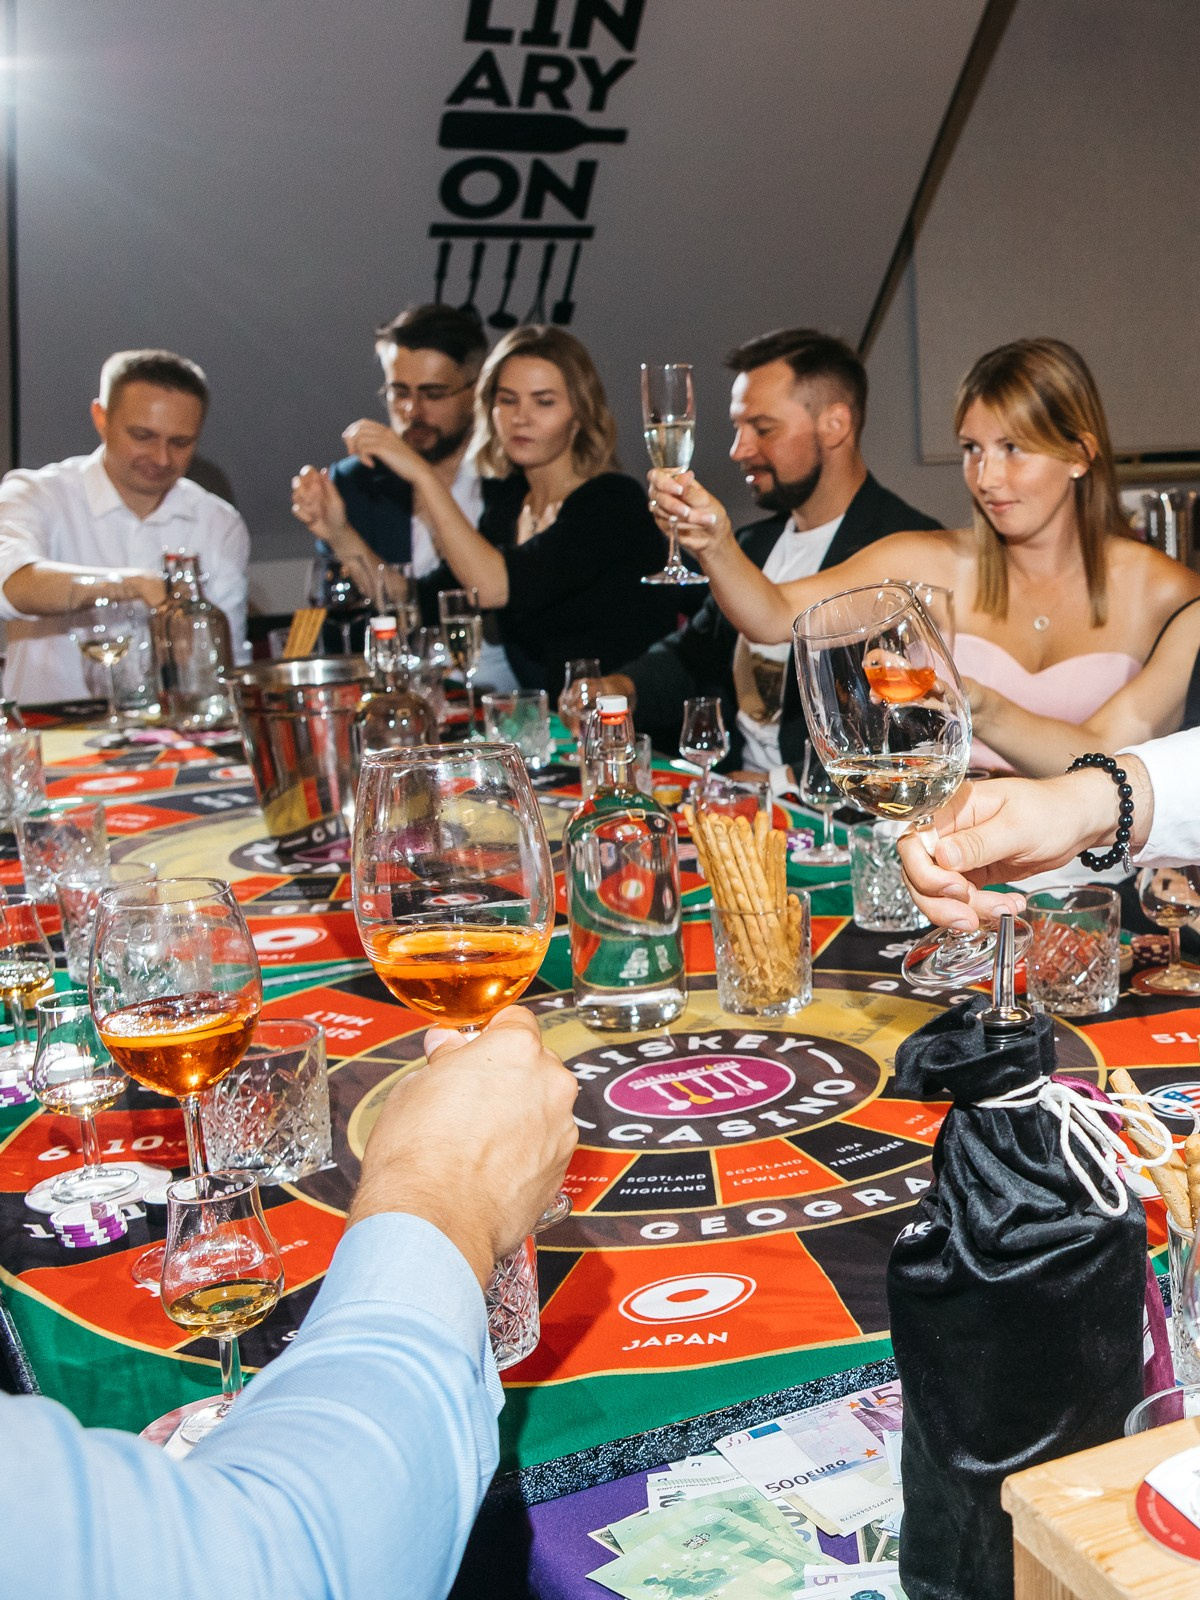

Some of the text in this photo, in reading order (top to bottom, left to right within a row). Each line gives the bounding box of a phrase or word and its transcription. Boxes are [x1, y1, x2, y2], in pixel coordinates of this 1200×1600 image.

[463, 0, 645, 52] LIN
[445, 49, 637, 113] ARY
[438, 155, 598, 221] ON
[572, 1033, 815, 1092] HISKEY
[607, 1079, 857, 1144] CASINO
[829, 1141, 905, 1168] TENNESSEE
[836, 1142, 863, 1153] USA
[626, 1173, 707, 1183] SCOTLAND
[726, 1158, 803, 1177] SCOTLAND
[732, 1168, 810, 1187] LOWLAND
[619, 1183, 707, 1195] HIGHLAND
[640, 1175, 933, 1240] GEOGRA
[621, 1330, 729, 1353] JAPAN
[764, 1473, 811, 1495] 500
[807, 1458, 848, 1479] EURO
